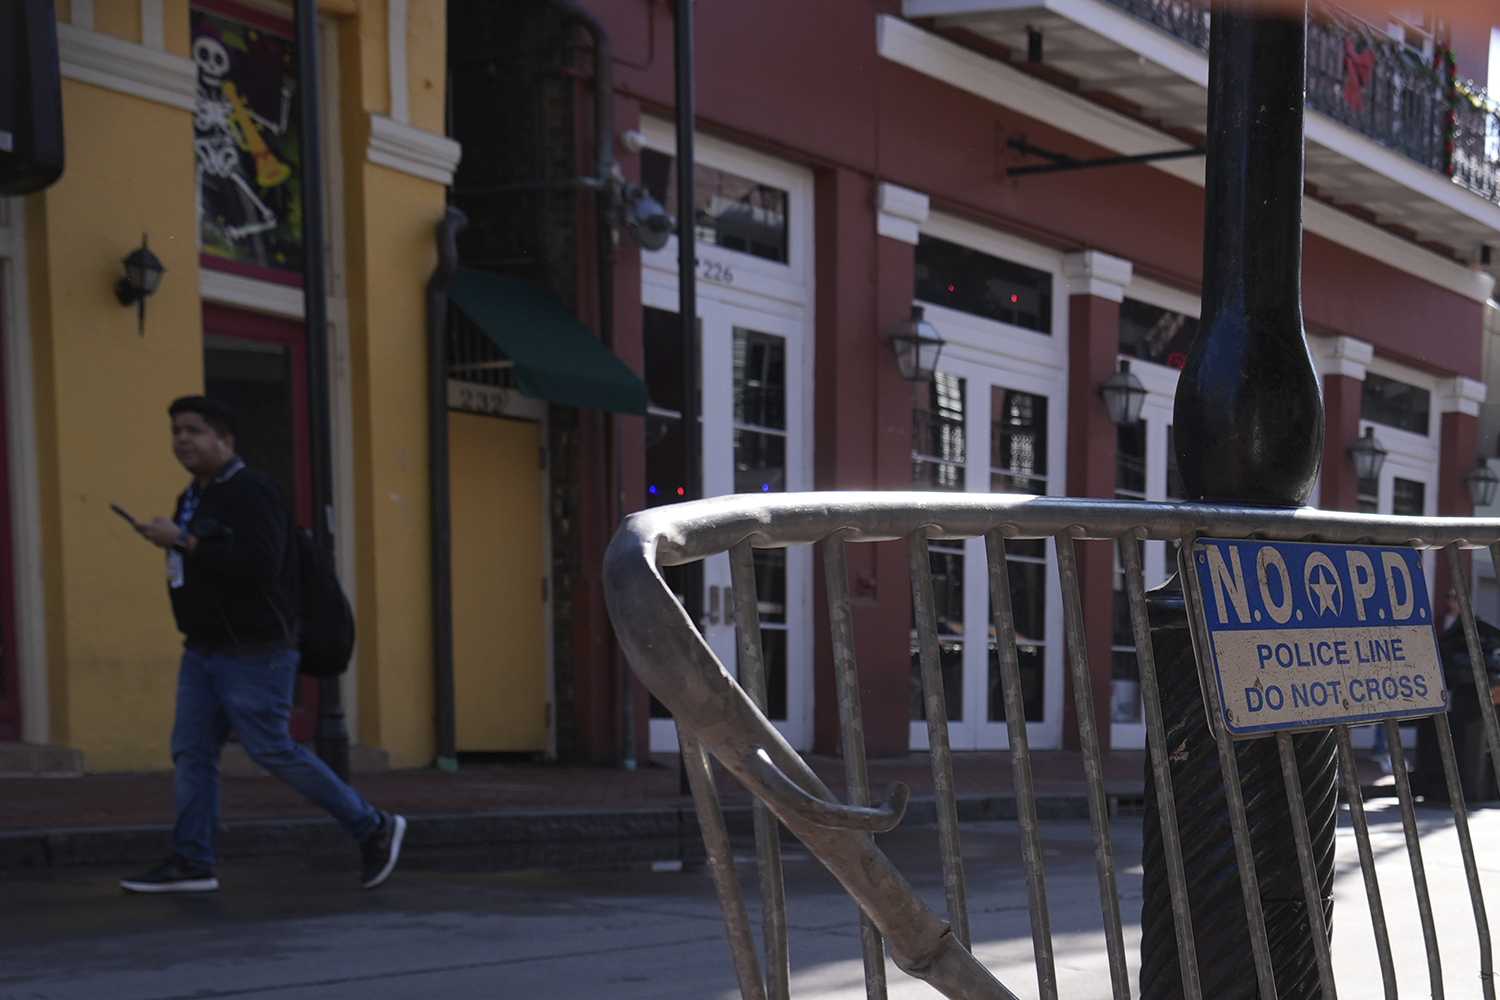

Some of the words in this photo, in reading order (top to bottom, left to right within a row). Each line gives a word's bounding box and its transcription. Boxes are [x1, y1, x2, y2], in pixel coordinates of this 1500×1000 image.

[704, 259, 733, 284] 226
[1257, 641, 1350, 669] POLICE
[1355, 639, 1406, 664] LINE
[1244, 685, 1284, 713] DO
[1292, 680, 1341, 708] NOT
[1349, 674, 1429, 703] CROSS
